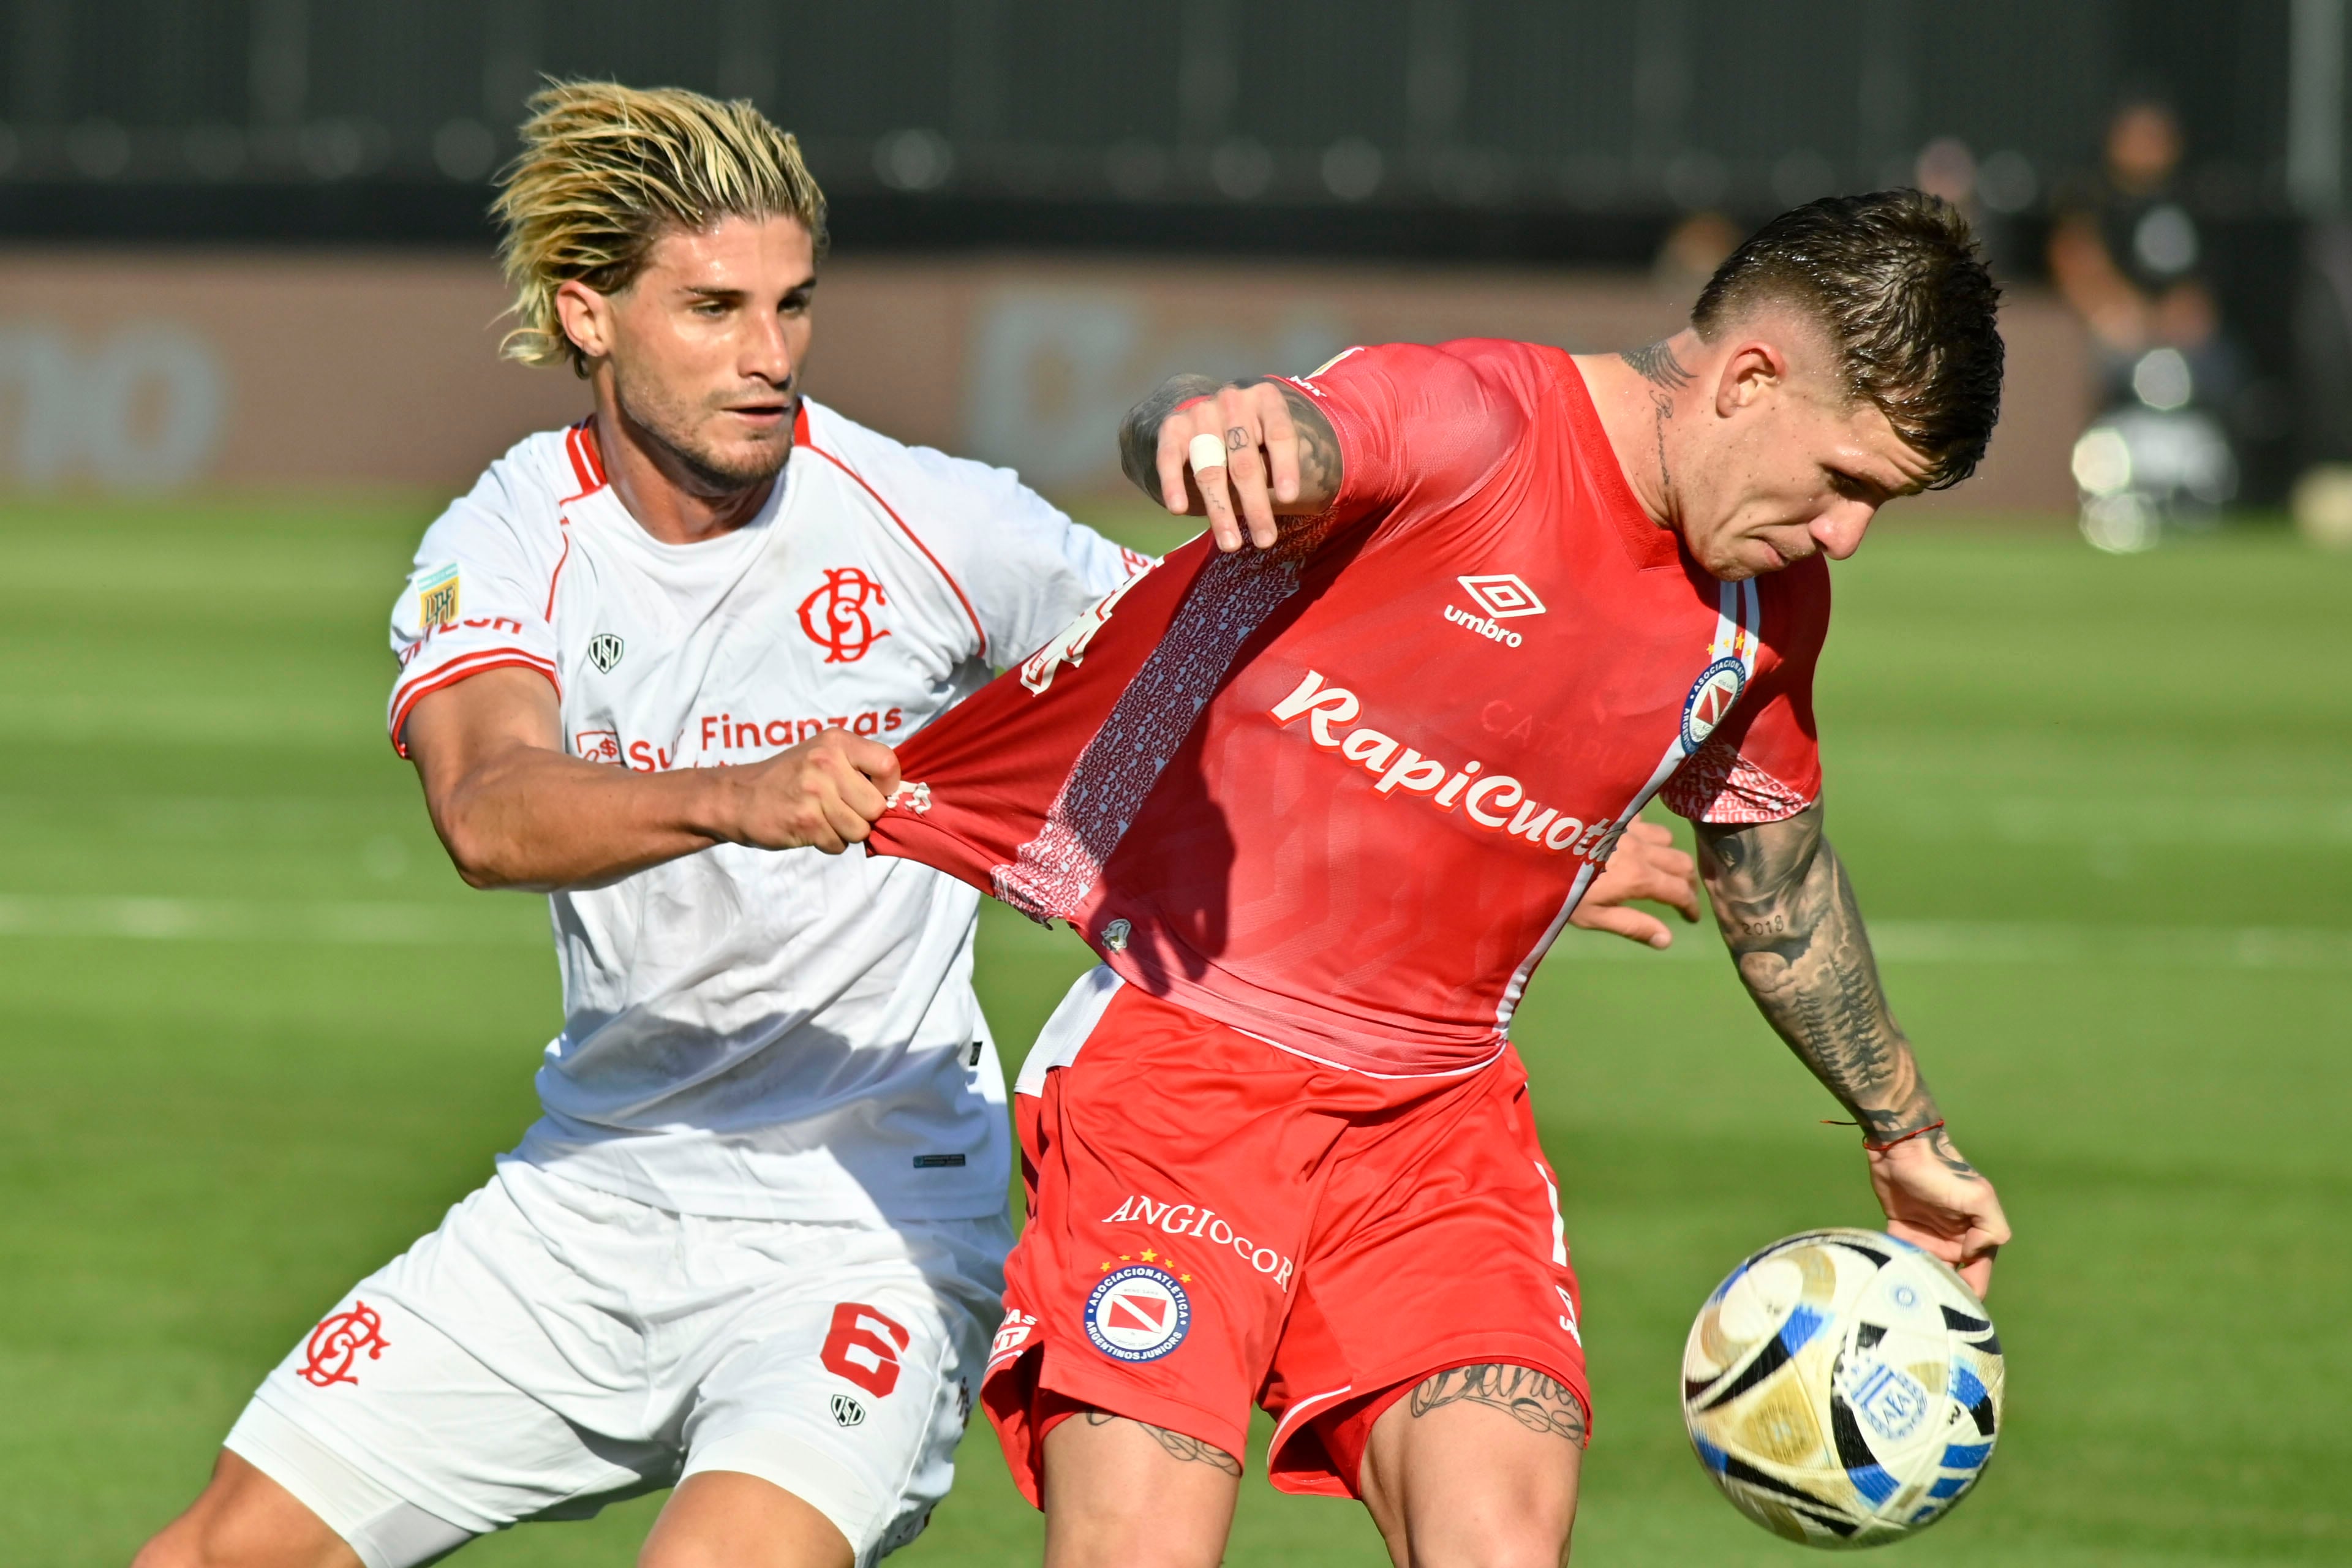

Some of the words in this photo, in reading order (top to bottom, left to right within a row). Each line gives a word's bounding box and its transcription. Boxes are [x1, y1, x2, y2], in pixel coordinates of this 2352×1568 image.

[1444, 604, 1523, 648] umbro
[1134, 688, 1194, 728] COLORADO
[1270, 670, 1624, 862] RapiCuota
[1103, 1195, 1295, 1294] ANGIOCOR
[1089, 1268, 1154, 1306] ASOCIACION
[1153, 1272, 1188, 1318] ATLETICA
[820, 1302, 910, 1398] 6
[1086, 1321, 1140, 1360] ARGENTINOS
[1140, 1332, 1183, 1360] JUNIORS
